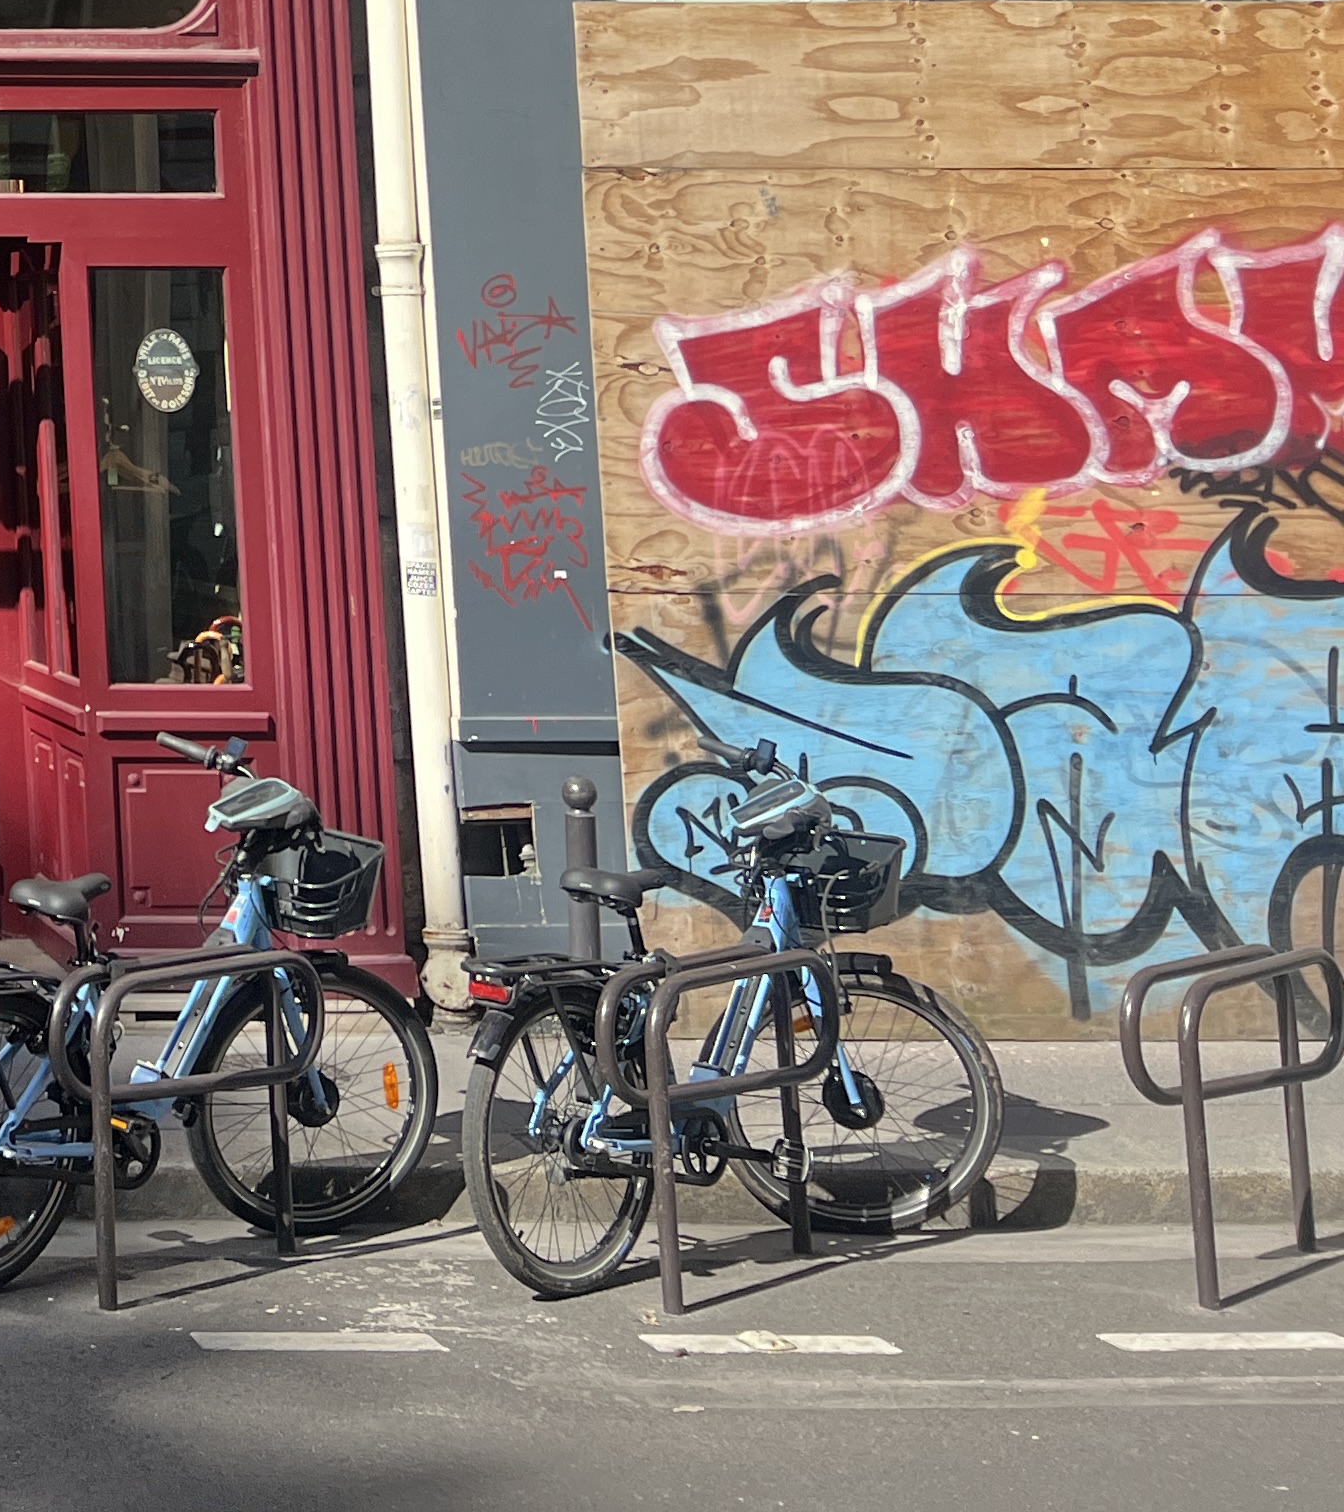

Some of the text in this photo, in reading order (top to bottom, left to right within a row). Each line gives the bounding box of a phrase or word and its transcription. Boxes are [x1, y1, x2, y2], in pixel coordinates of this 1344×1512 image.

[138, 333, 159, 360] VILLE
[167, 332, 192, 361] PARIS
[147, 356, 183, 365] LICENCE
